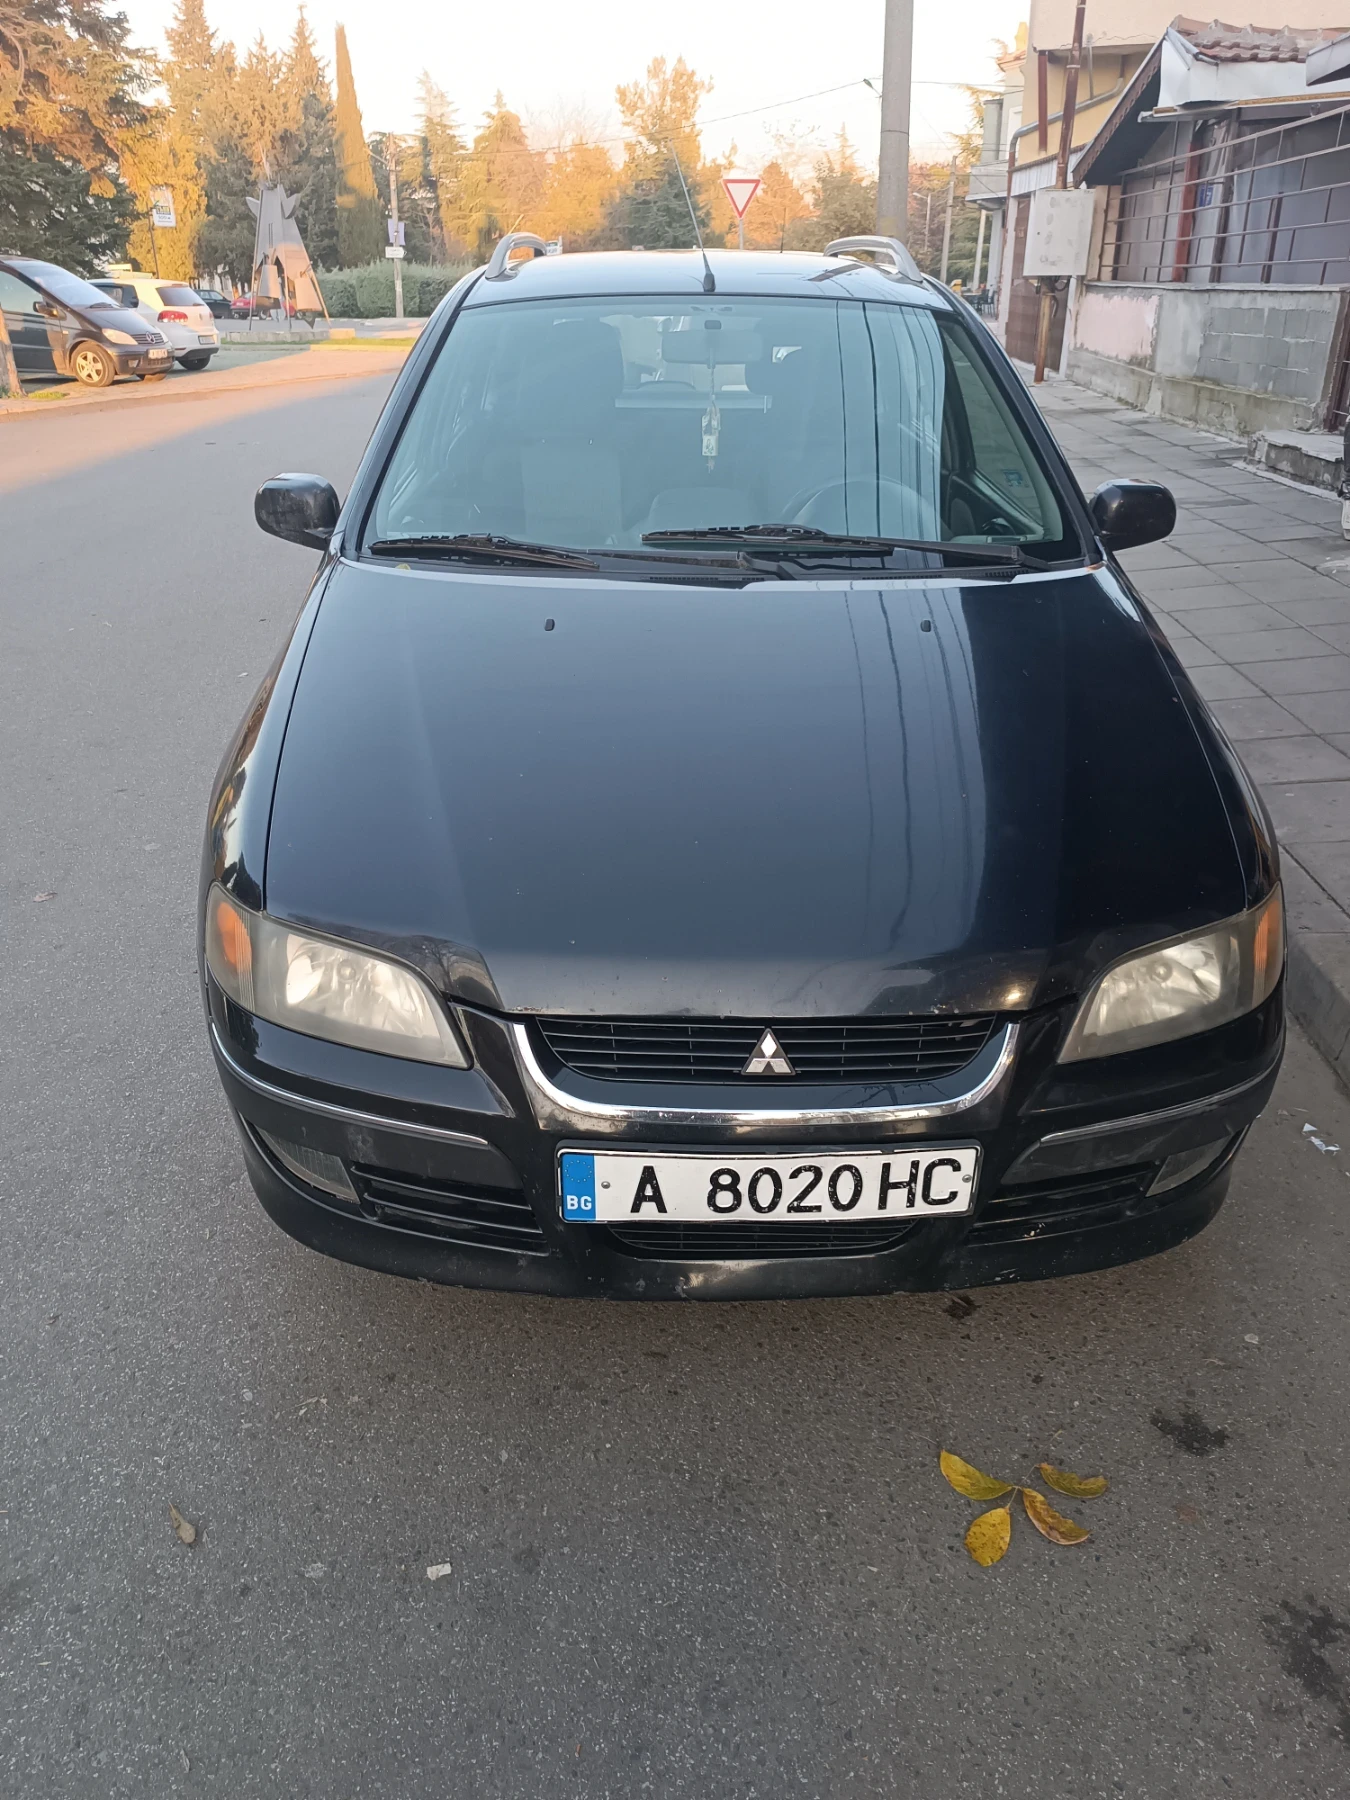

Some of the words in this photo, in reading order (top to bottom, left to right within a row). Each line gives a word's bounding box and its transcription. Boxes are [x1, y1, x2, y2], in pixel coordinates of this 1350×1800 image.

[566, 1195, 592, 1210] BG
[630, 1165, 668, 1213] A
[706, 1163, 863, 1214] 8020
[877, 1157, 962, 1210] HC
